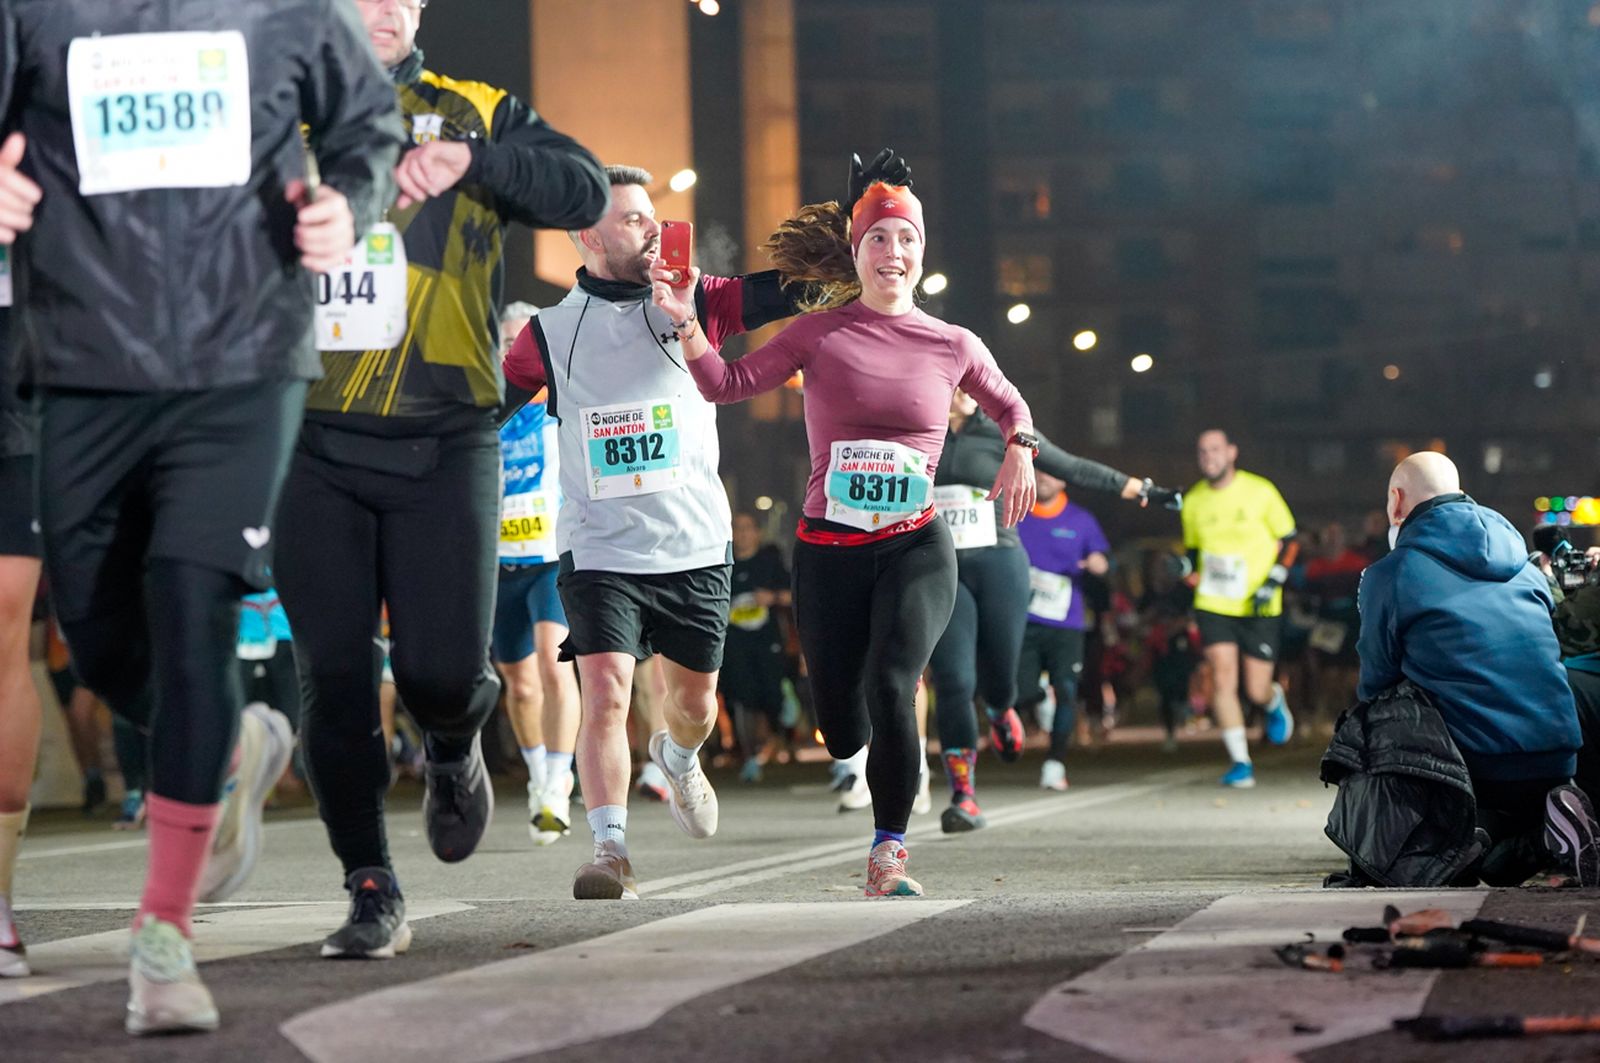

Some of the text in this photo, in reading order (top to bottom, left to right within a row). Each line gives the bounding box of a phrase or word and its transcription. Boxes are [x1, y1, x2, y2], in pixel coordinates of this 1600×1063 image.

[95, 91, 224, 135] 13589
[602, 413, 631, 425] NOCHE
[632, 411, 644, 421] DE
[593, 427, 611, 438] SAN
[613, 422, 646, 436] ANTÓN
[604, 433, 665, 466] 8312
[851, 450, 895, 461] NOCHE DE
[840, 462, 859, 472] SAN
[848, 473, 910, 503] 8311
